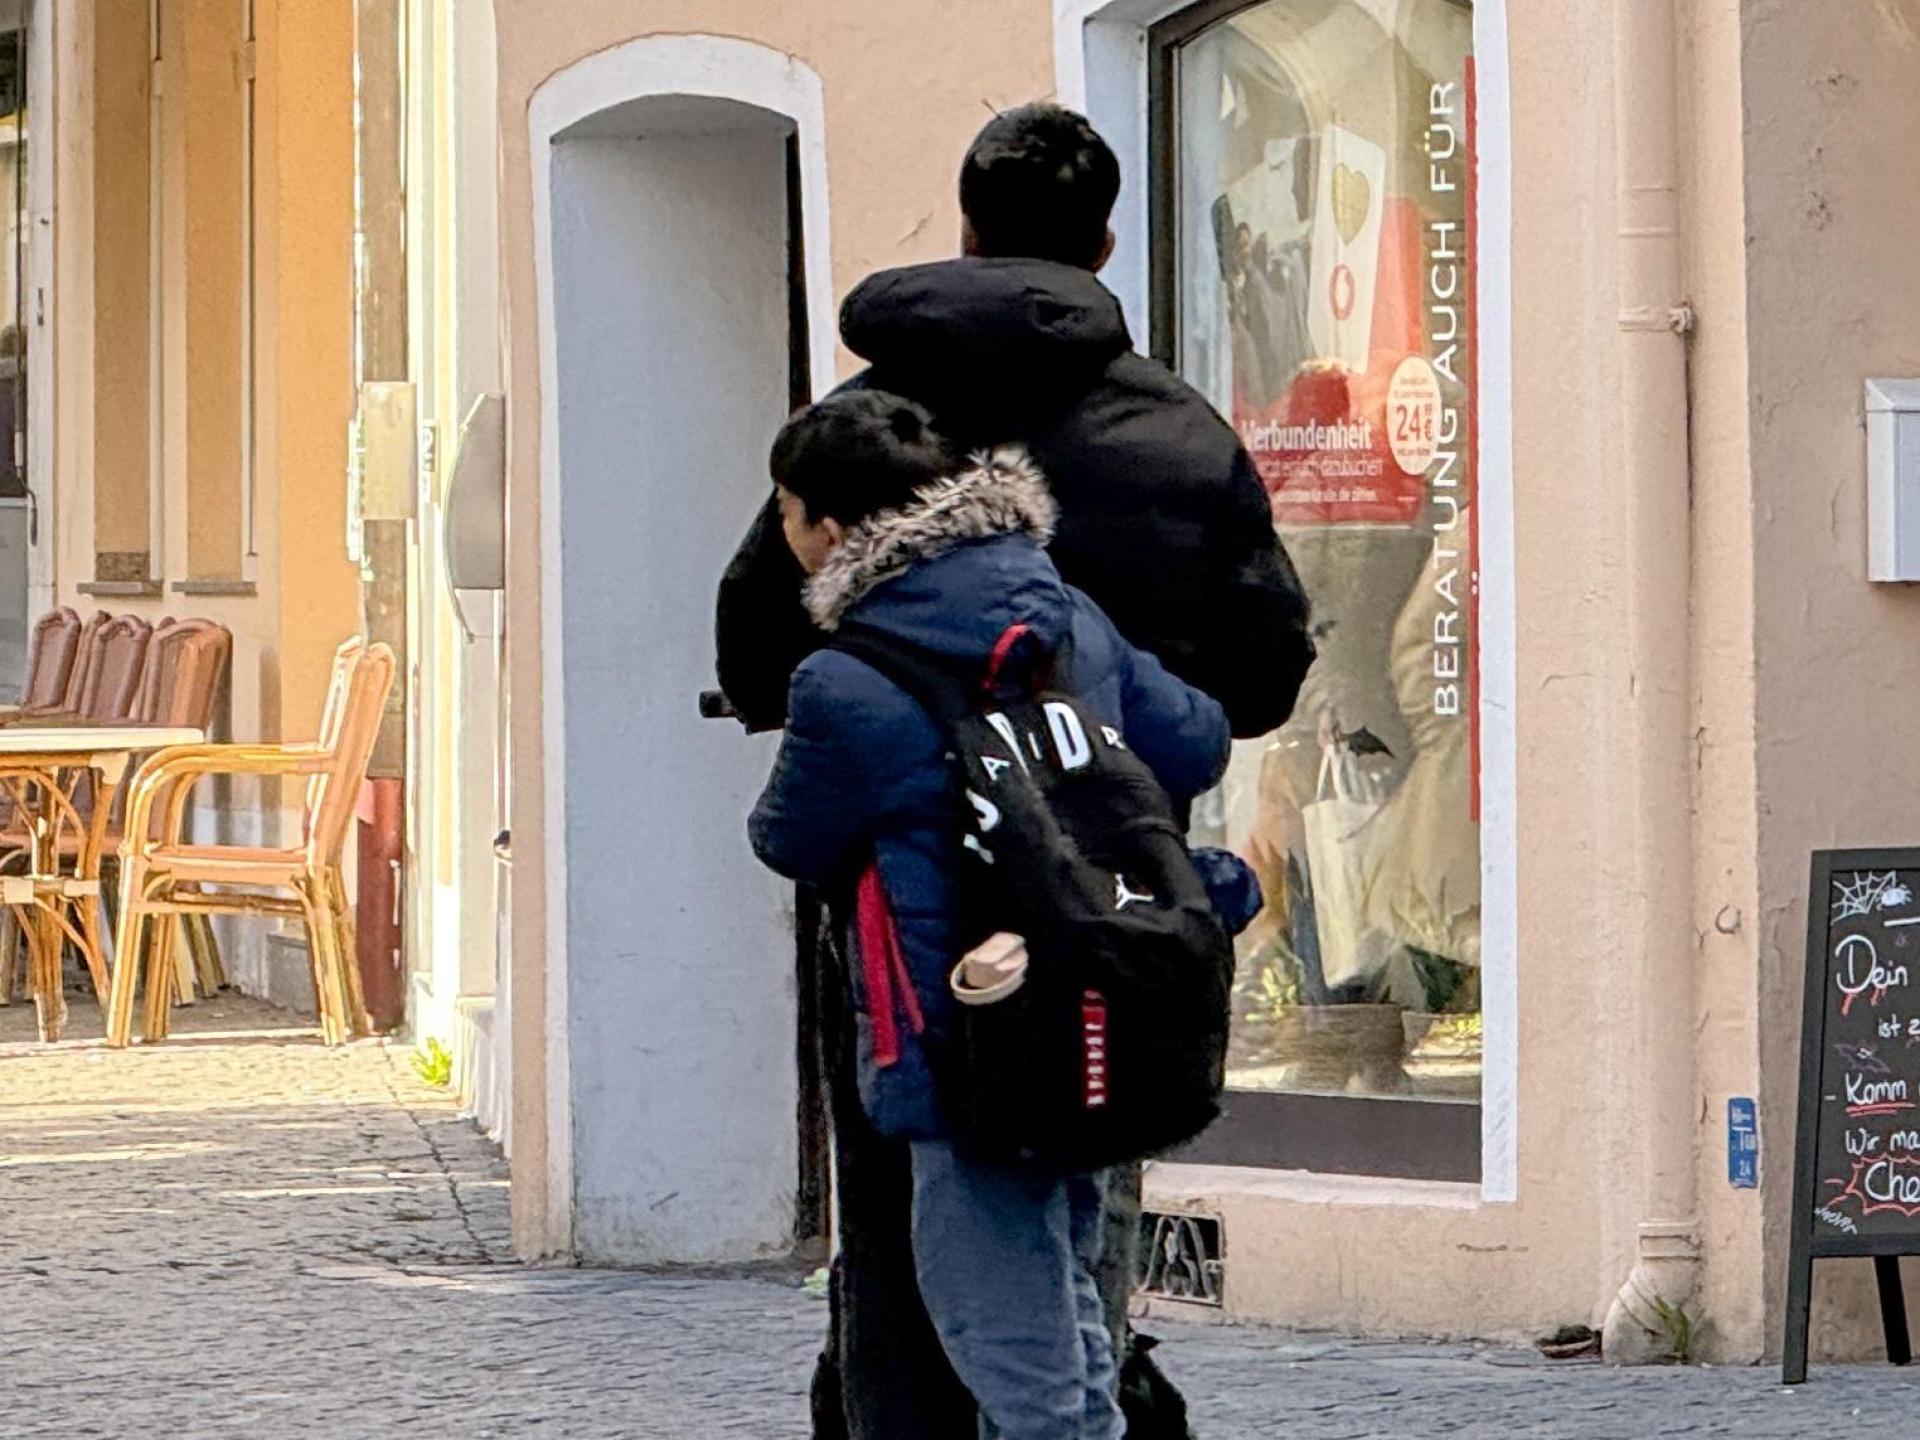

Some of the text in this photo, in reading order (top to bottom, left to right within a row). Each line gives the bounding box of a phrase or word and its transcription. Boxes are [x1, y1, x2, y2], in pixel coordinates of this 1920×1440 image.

[1424, 82, 1459, 717] BERATUNG AUCH FÜR
[1242, 417, 1373, 451] Verbundenheit
[1396, 403, 1421, 441] 24
[1835, 934, 1908, 994] Dein
[1878, 1013, 1901, 1038] ist
[1845, 1073, 1907, 1106] Komm
[1845, 1127, 1880, 1155] Wir
[1865, 1161, 1920, 1202] Che
